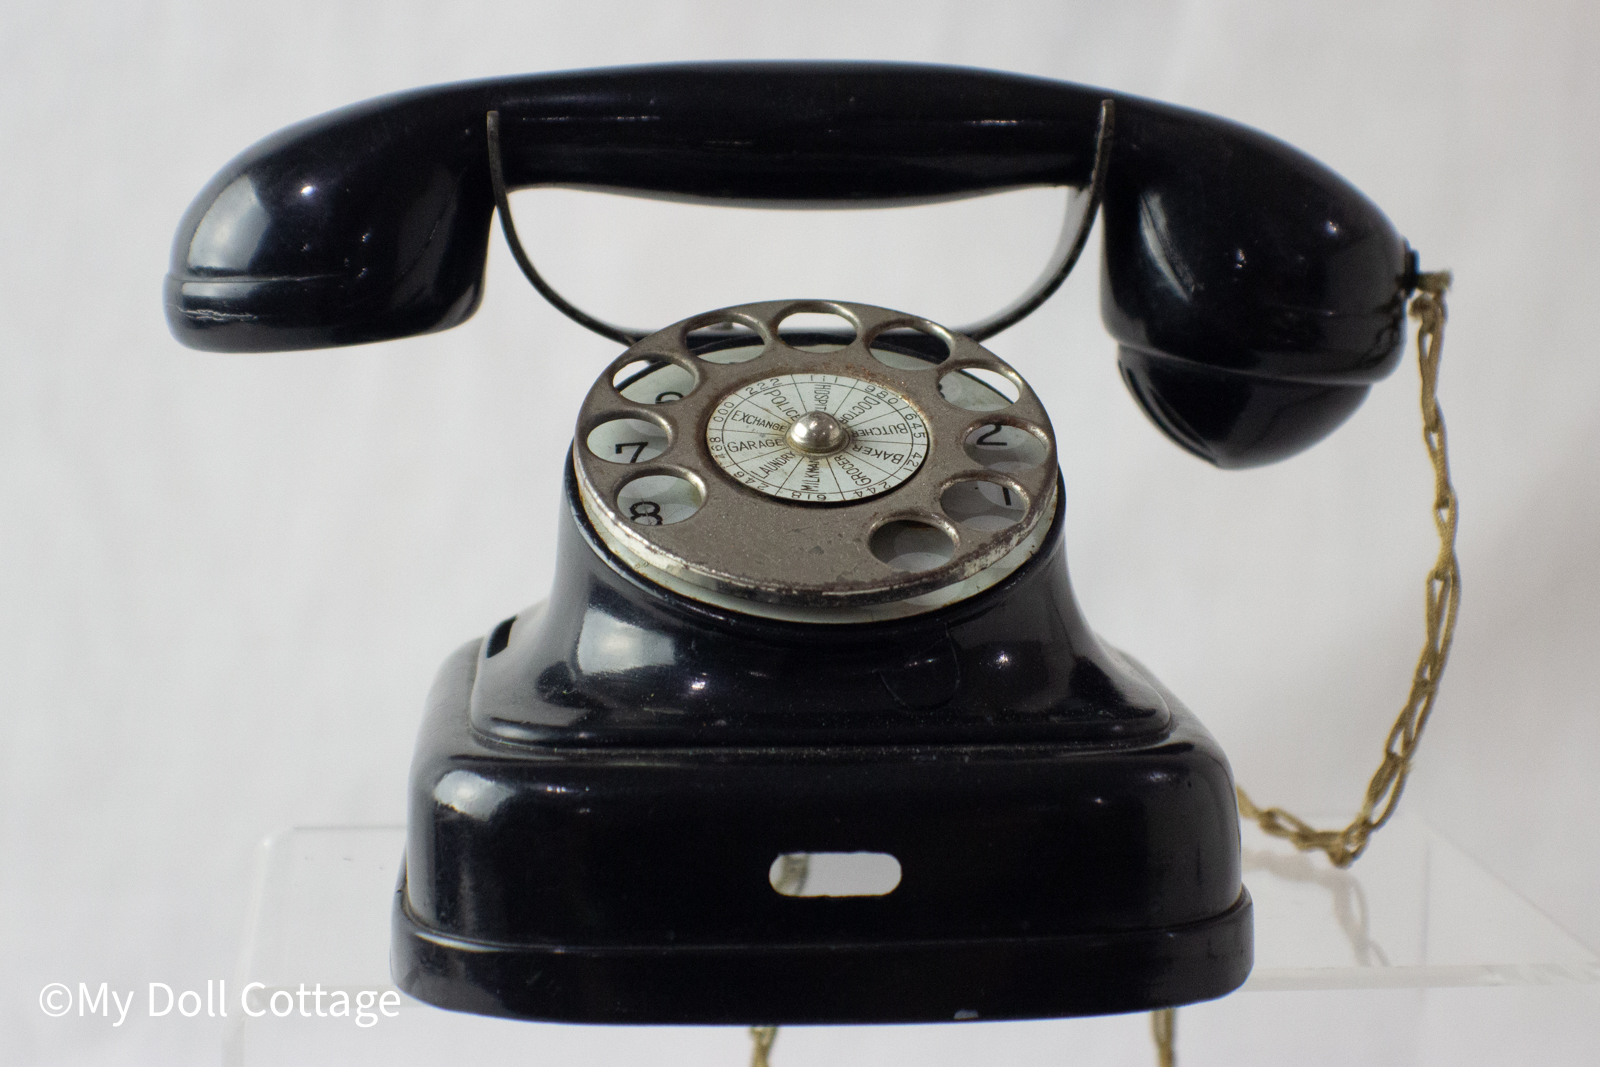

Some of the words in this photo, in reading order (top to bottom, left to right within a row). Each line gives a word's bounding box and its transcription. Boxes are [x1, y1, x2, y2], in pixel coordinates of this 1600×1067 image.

[745, 378, 782, 395] 222
[814, 384, 831, 411] HOSPIT
[864, 384, 899, 405] 980
[713, 401, 735, 423] 000
[763, 389, 800, 422] POLICE
[840, 395, 880, 424] DOCTOR
[731, 410, 787, 433] EXCHANGE
[851, 422, 908, 438] BUTCHER
[904, 413, 926, 439] 645
[727, 438, 783, 453] GARAGE
[976, 424, 1008, 446] 2
[615, 441, 648, 464] 7
[852, 444, 905, 465] BAKER
[903, 452, 923, 472] 421
[750, 450, 796, 480] LAUNDRY
[834, 454, 872, 487] GROCER
[733, 471, 769, 491] 246
[854, 481, 892, 498] 244
[791, 490, 827, 501] 618
